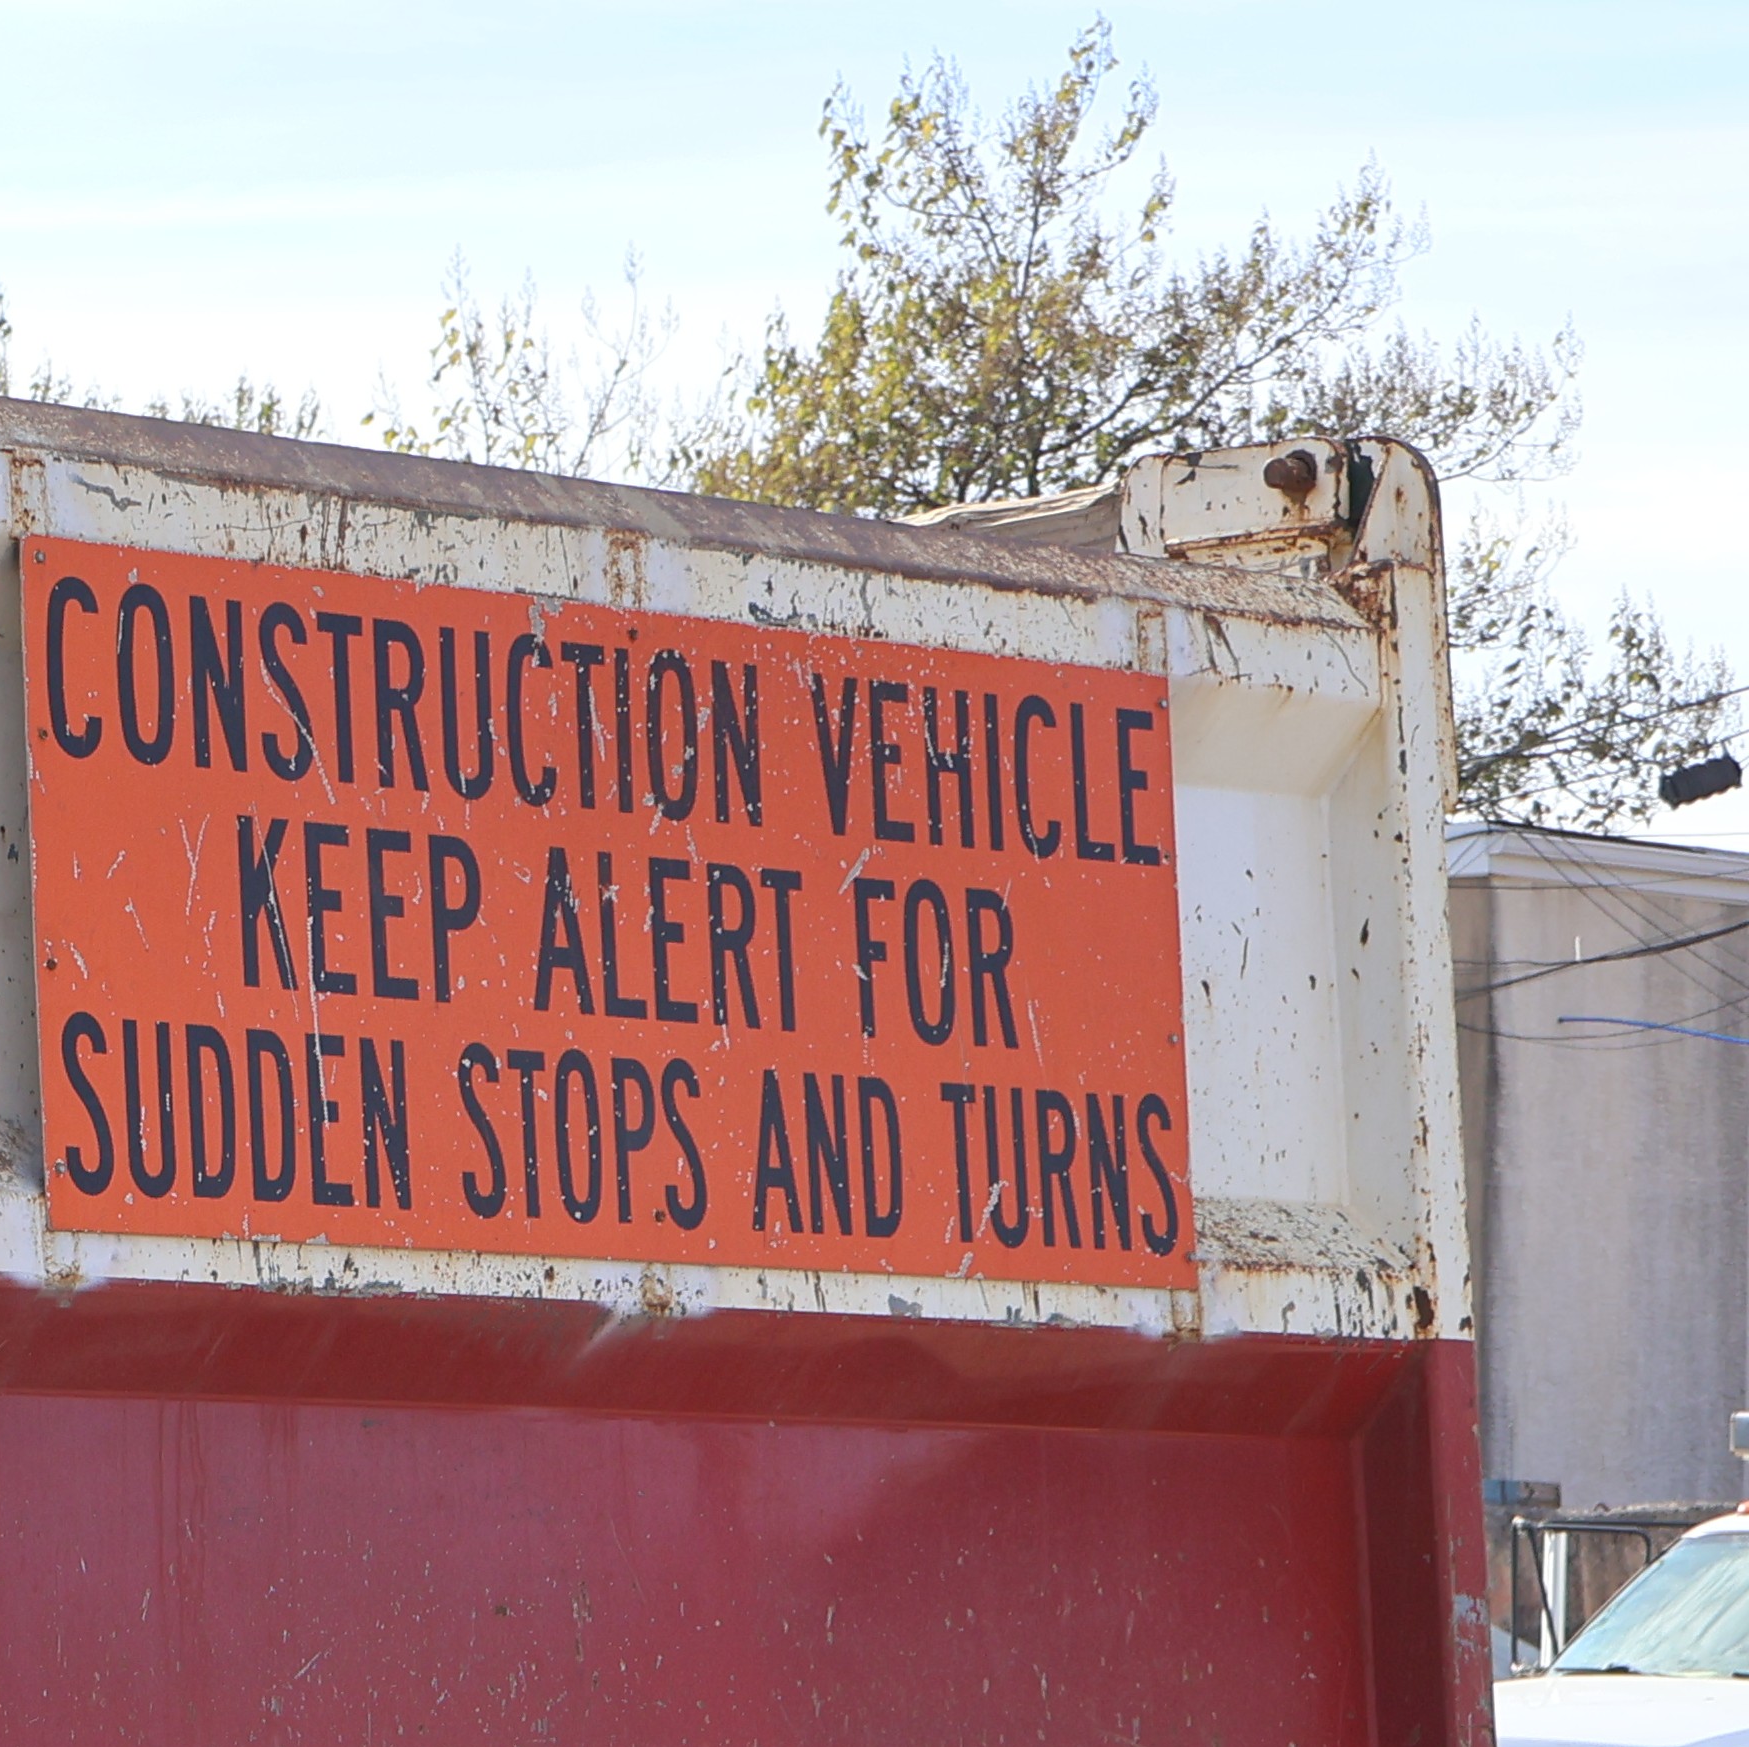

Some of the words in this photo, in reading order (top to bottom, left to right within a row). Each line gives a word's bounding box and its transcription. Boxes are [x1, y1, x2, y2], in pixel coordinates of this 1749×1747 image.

[46, 576, 763, 827] CONSTRUCTION
[810, 672, 1162, 867] VEHICLE
[236, 814, 481, 1003] KEEP
[533, 846, 802, 1032] ALERT
[852, 876, 1019, 1049] FOR
[58, 1011, 412, 1210] SUDDEN
[457, 1042, 708, 1231] STOPS
[752, 1069, 903, 1238] AND
[940, 1082, 1180, 1257] TURNS
